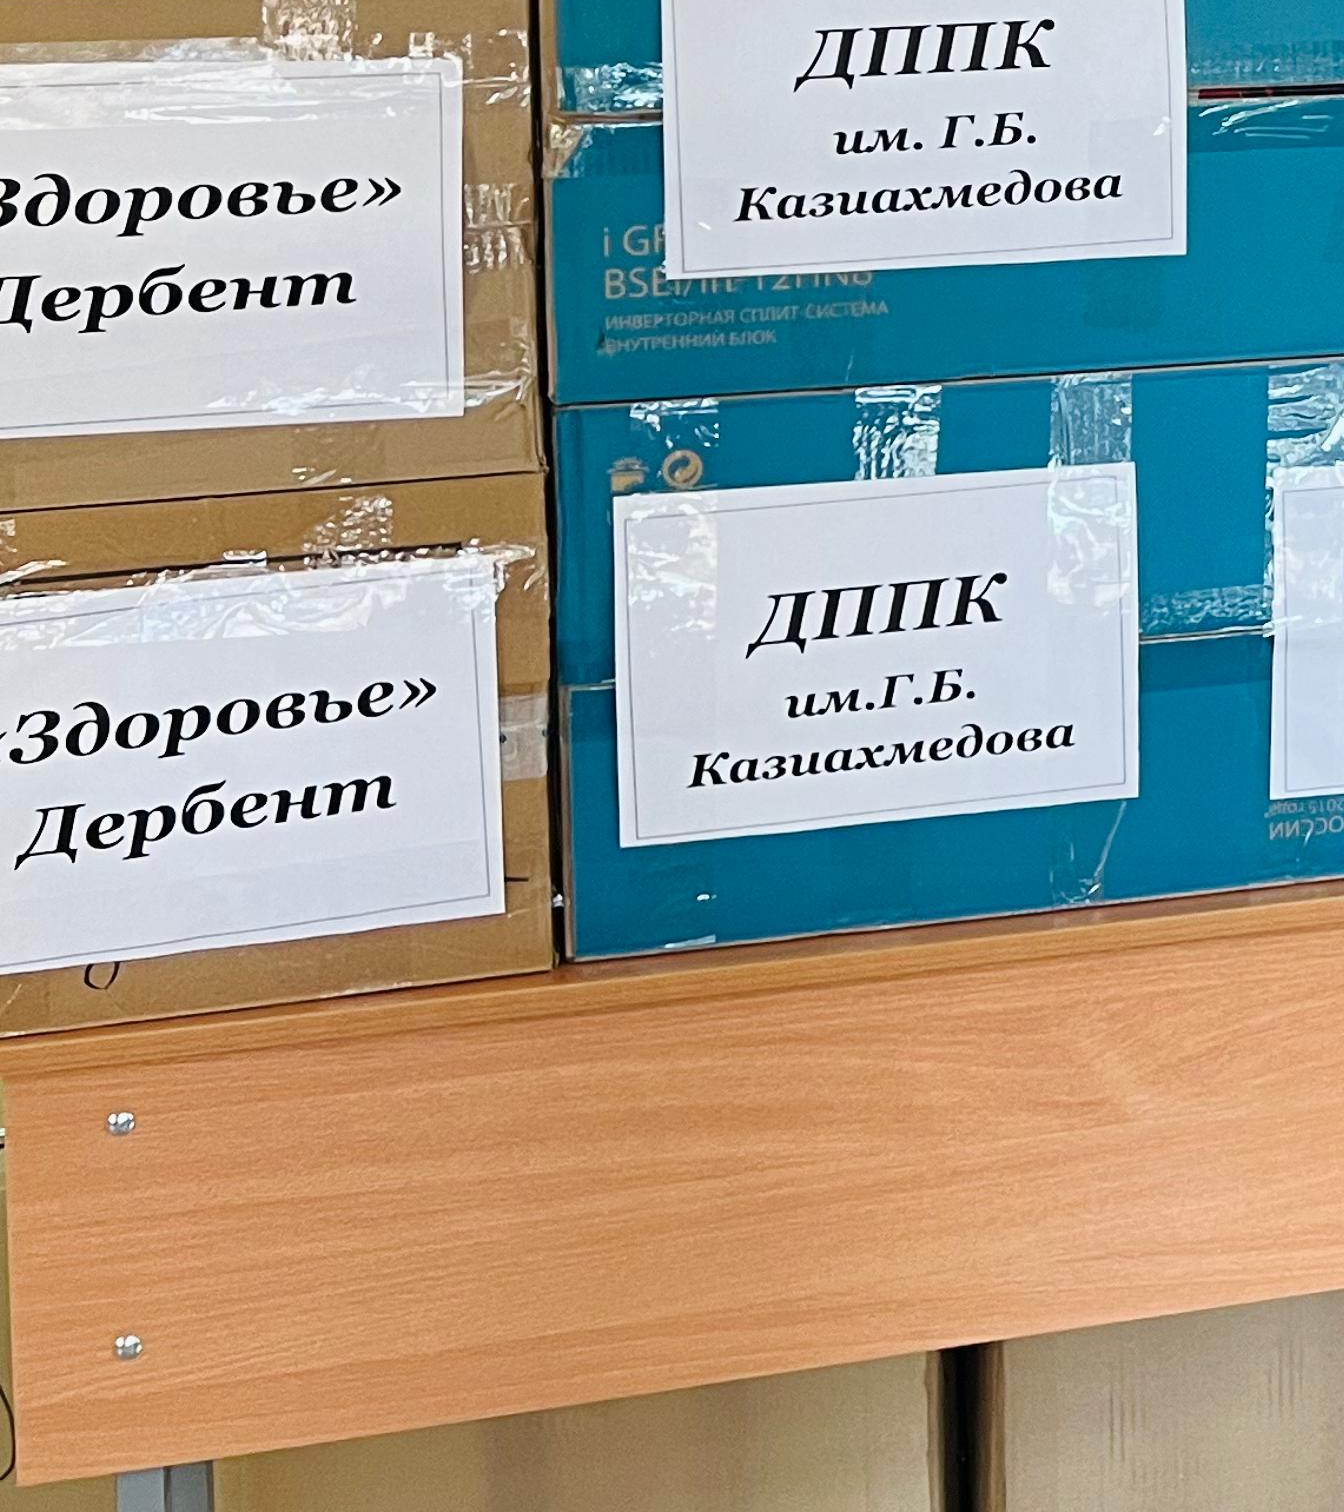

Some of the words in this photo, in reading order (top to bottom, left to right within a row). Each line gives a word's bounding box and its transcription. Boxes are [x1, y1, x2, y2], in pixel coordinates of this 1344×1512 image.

[793, 17, 1055, 94] ДППК
[833, 122, 923, 157] им.
[938, 110, 1038, 150] Г.Б.
[733, 168, 1124, 224] Казиахмедова
[605, 307, 735, 331] ИНВЕРТОРНАЯ
[805, 299, 889, 320] СИСТЕМА
[745, 571, 1008, 659] ДППК
[0, 676, 437, 765] Здоровье»
[785, 667, 977, 721] им.Г.Б.
[687, 721, 1076, 789] Казиахмедова
[14, 774, 397, 871] Дербент
